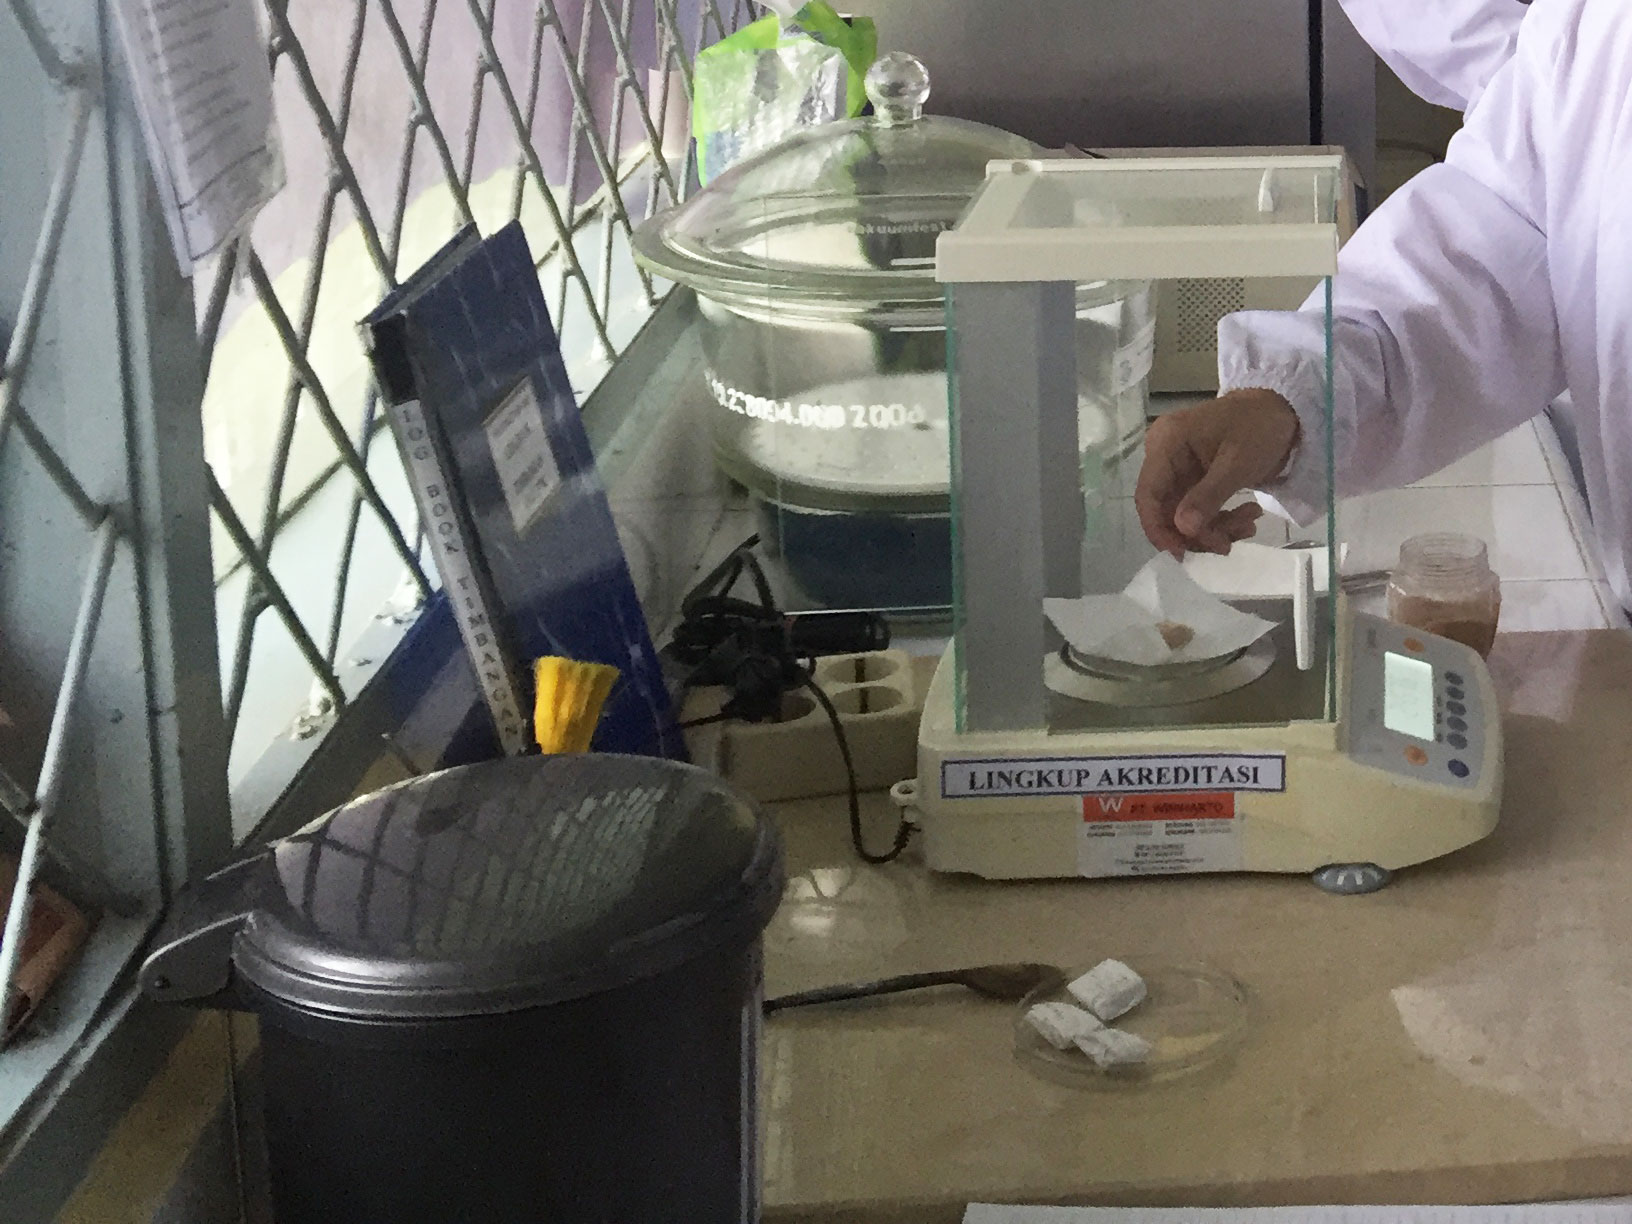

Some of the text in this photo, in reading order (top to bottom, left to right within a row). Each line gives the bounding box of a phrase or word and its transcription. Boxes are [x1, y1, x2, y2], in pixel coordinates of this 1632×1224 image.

[400, 409, 429, 461] LOG
[426, 483, 459, 554] BOOK
[968, 764, 1260, 792] LINGKUP AKREDITASI
